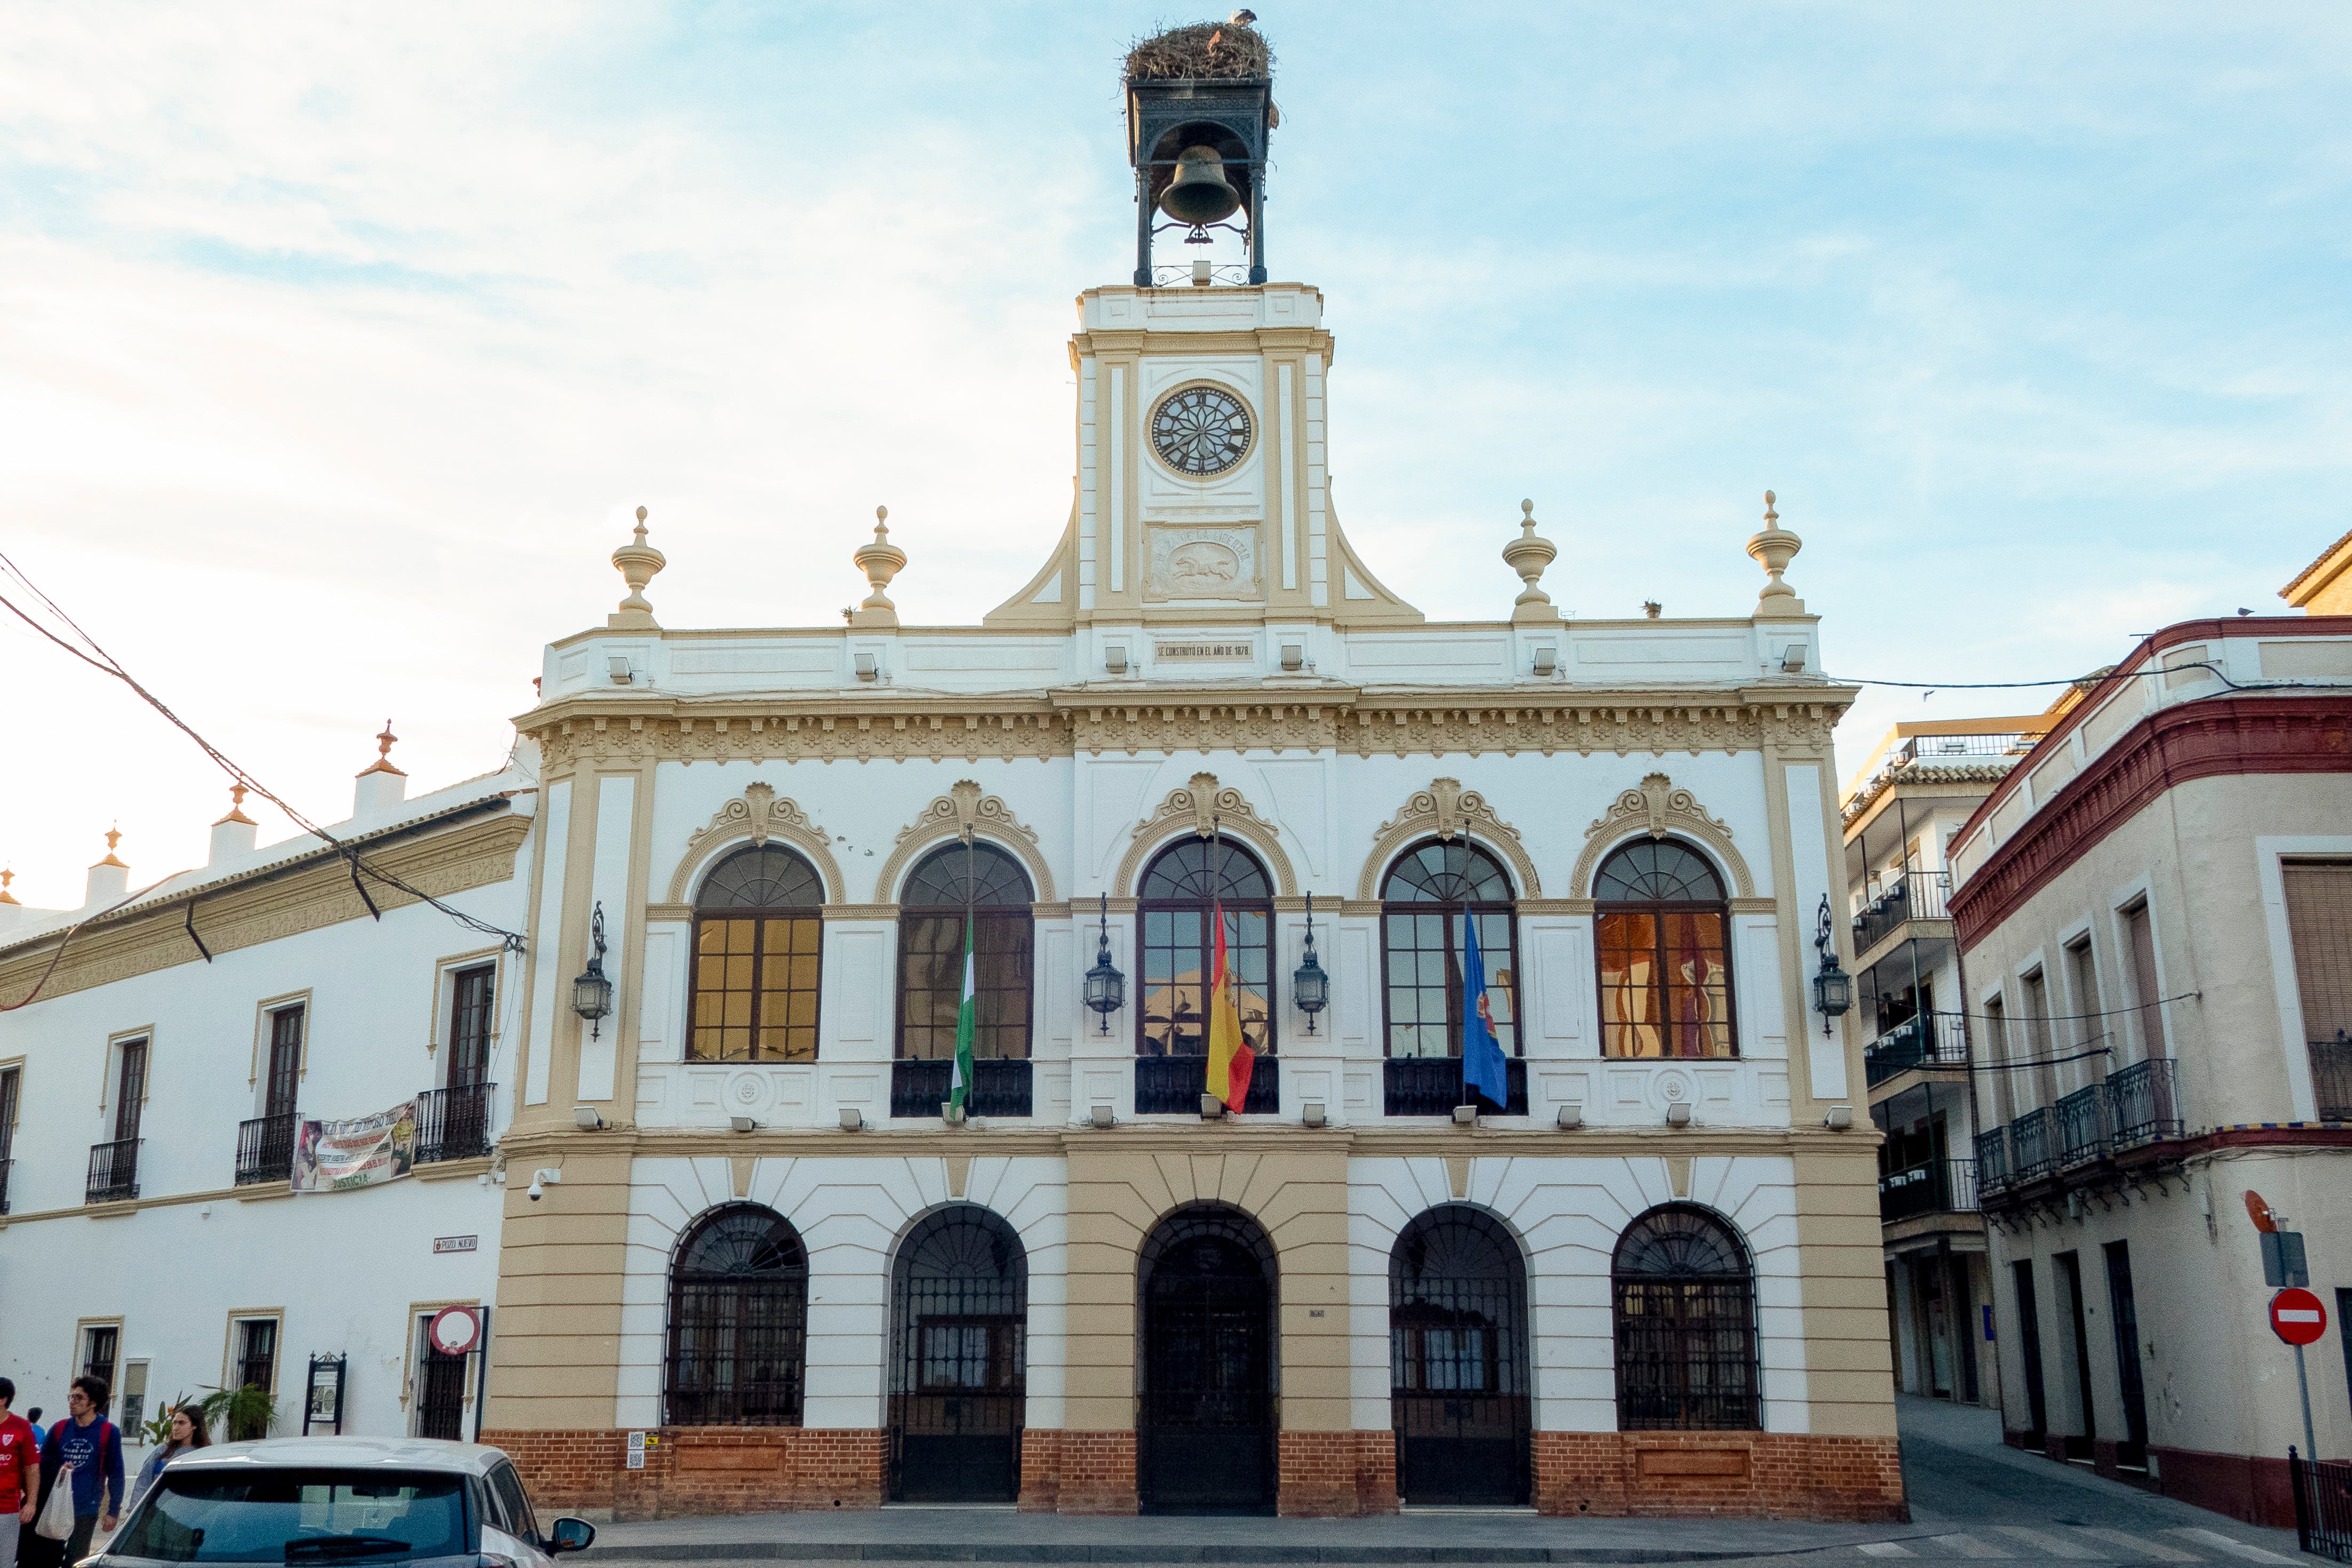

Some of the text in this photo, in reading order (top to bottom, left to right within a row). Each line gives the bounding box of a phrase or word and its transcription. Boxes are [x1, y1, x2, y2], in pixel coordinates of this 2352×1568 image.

[1158, 646, 1164, 656] SE
[1166, 644, 1195, 656] CONSTRUYÓ
[1197, 646, 1203, 655] EN
[1205, 646, 1210, 655] EL
[1213, 645, 1224, 655] AÑO
[1225, 646, 1232, 655] DE
[458, 1238, 476, 1249] NUEVO
